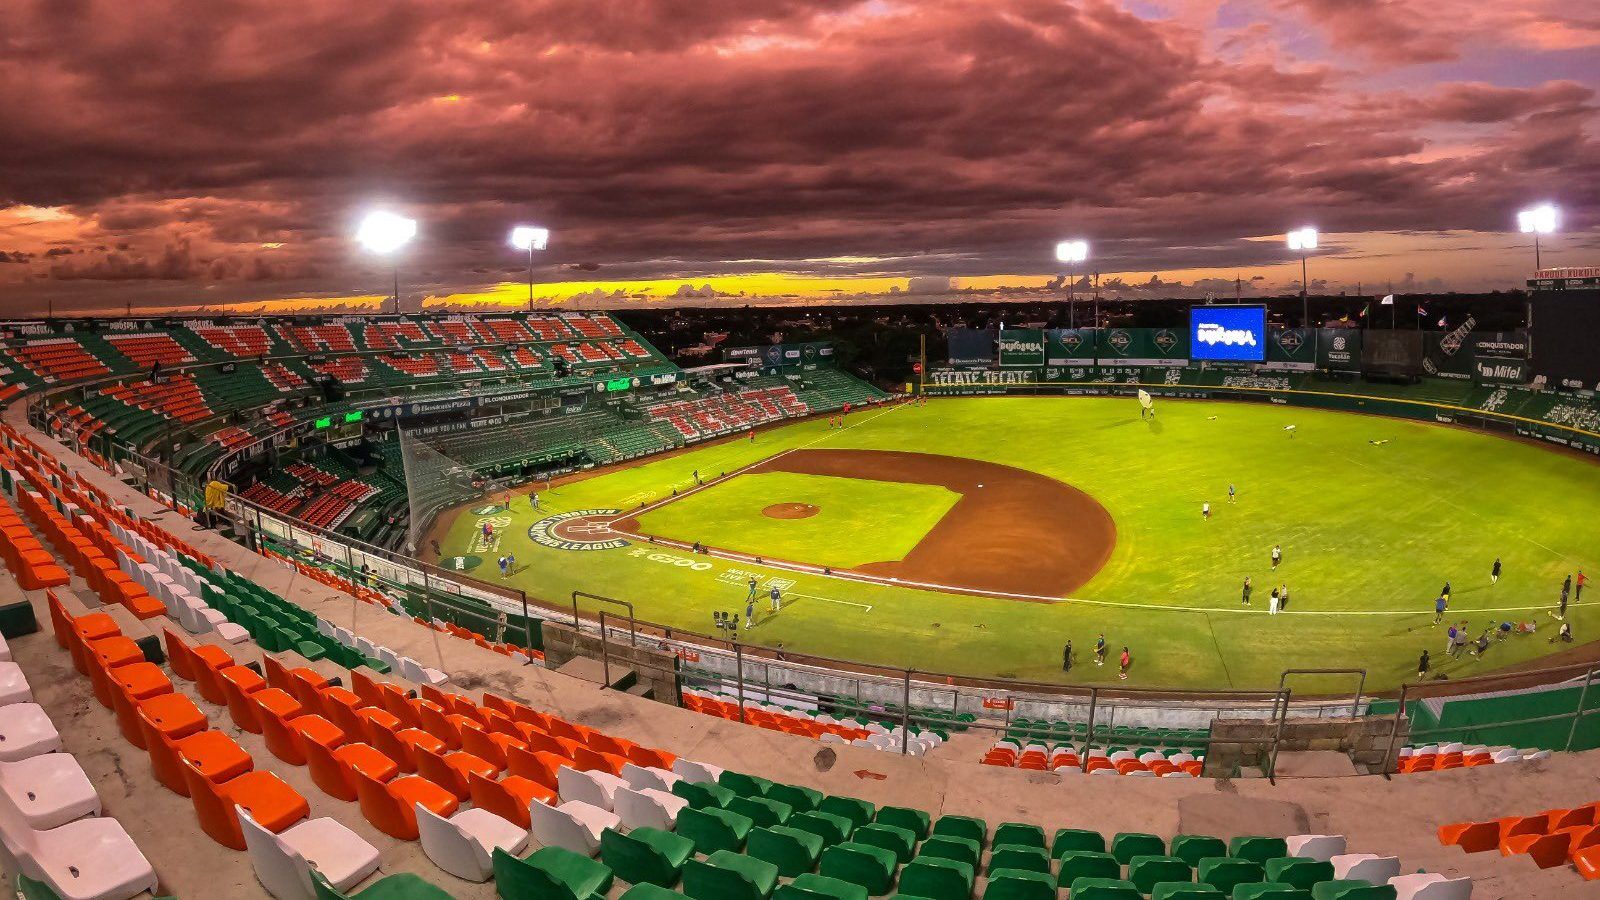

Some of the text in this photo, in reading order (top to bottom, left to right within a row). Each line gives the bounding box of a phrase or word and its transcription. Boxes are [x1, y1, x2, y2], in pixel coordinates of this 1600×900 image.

[1534, 270, 1564, 278] PARQUE
[1478, 342, 1524, 350] CONQUISTADOR
[982, 370, 1033, 384] TECATE
[1494, 365, 1521, 379] Mifel
[561, 540, 624, 550] LEAGUE
[726, 568, 766, 580] WATCH
